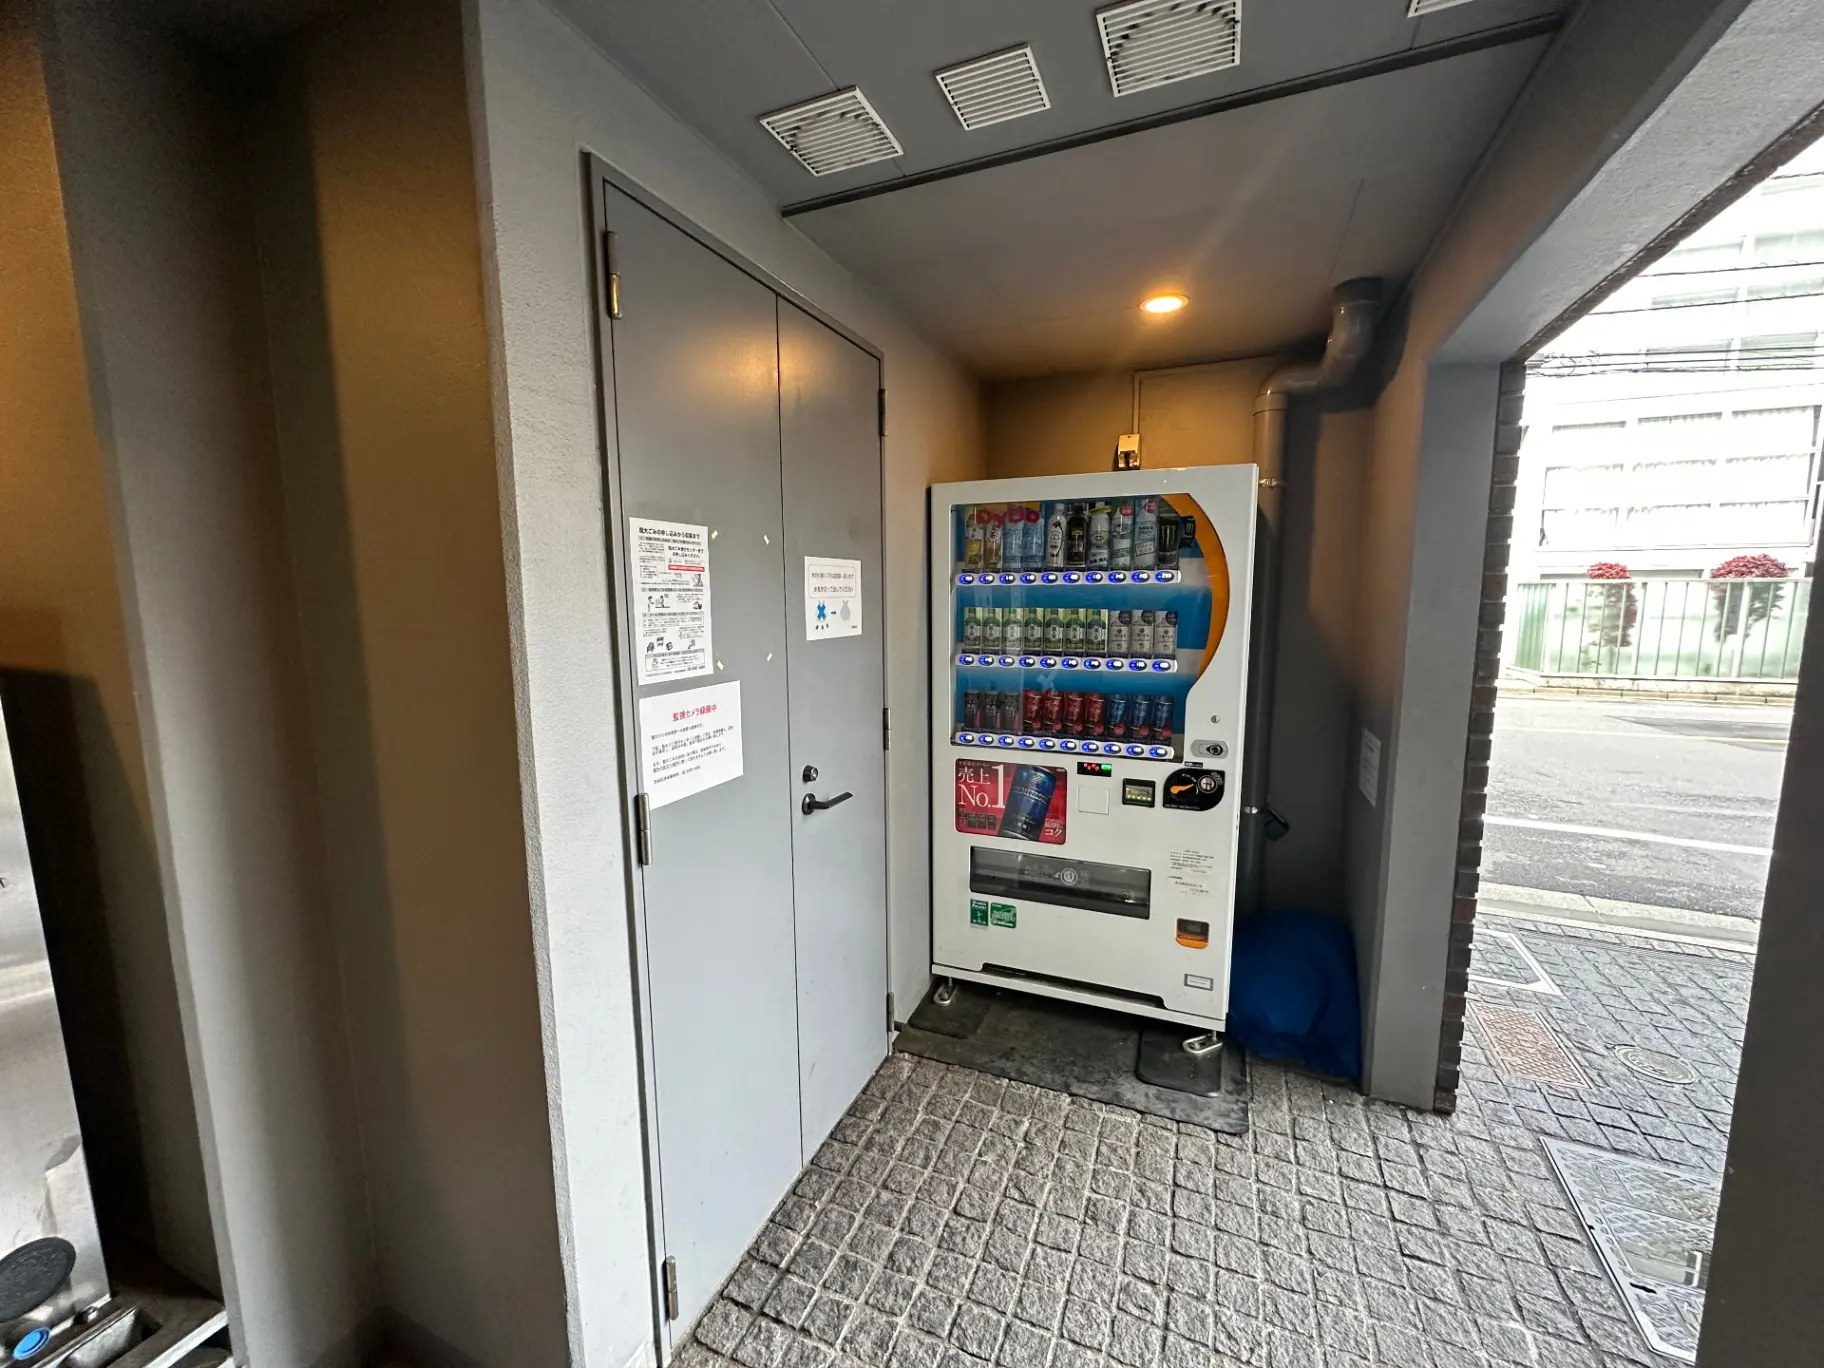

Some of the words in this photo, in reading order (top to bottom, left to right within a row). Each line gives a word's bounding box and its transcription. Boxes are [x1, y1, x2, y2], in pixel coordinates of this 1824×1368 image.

[976, 507, 1040, 528] DyDo
[958, 766, 991, 785] 売上
[1045, 828, 1063, 838] コク
